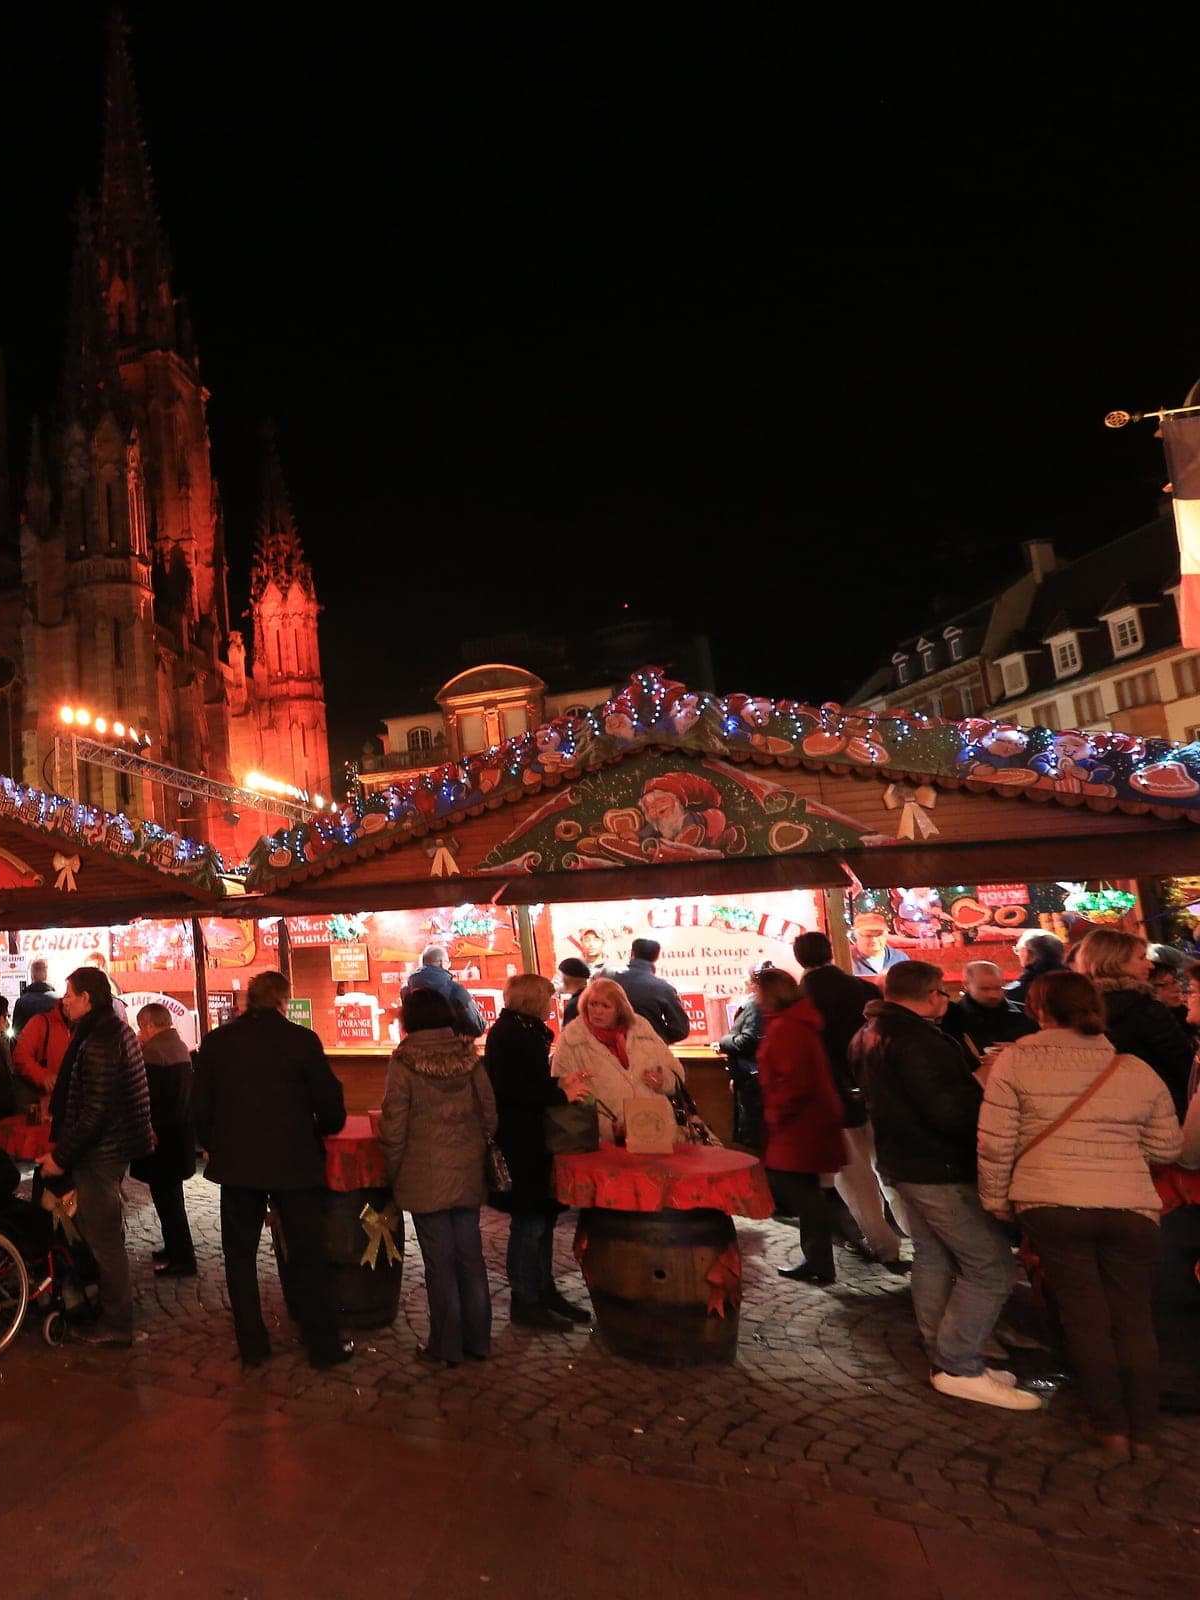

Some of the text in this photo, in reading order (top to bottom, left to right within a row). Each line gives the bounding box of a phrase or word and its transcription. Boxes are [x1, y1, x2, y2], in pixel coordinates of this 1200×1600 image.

[978, 891, 1027, 900] ROUGE
[701, 944, 750, 961] Rouge
[657, 966, 744, 977] haud Blan
[338, 1019, 371, 1028] D'ORANGE
